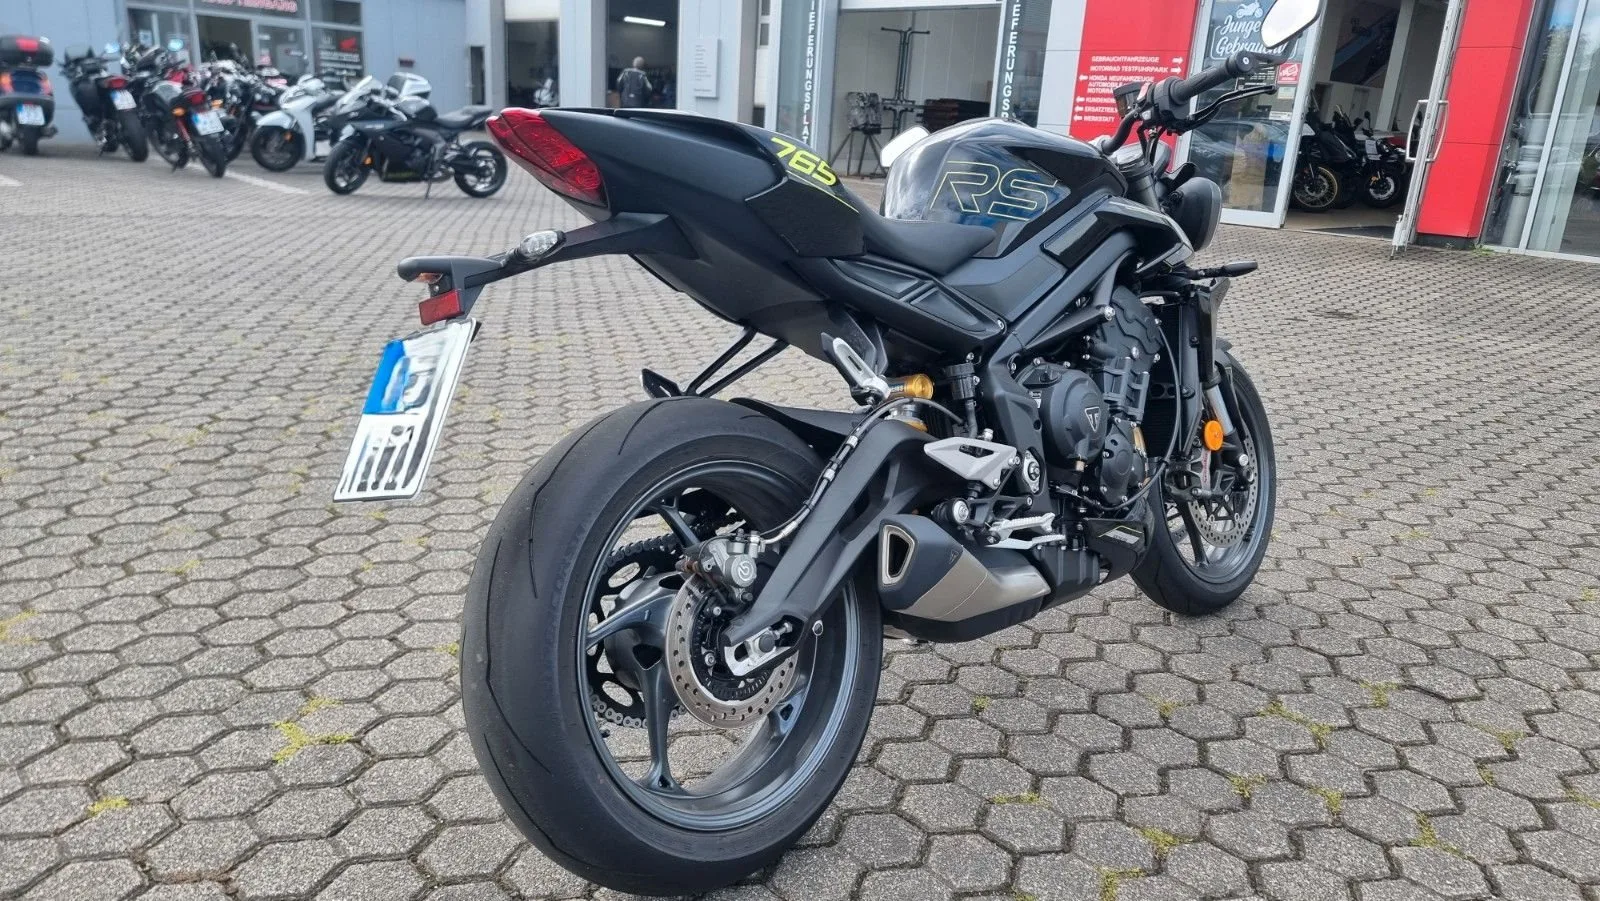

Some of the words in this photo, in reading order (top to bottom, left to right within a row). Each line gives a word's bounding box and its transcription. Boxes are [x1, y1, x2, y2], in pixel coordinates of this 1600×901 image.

[1220, 15, 1262, 39] Junge
[771, 137, 837, 186] 765
[930, 160, 1058, 222] RS
